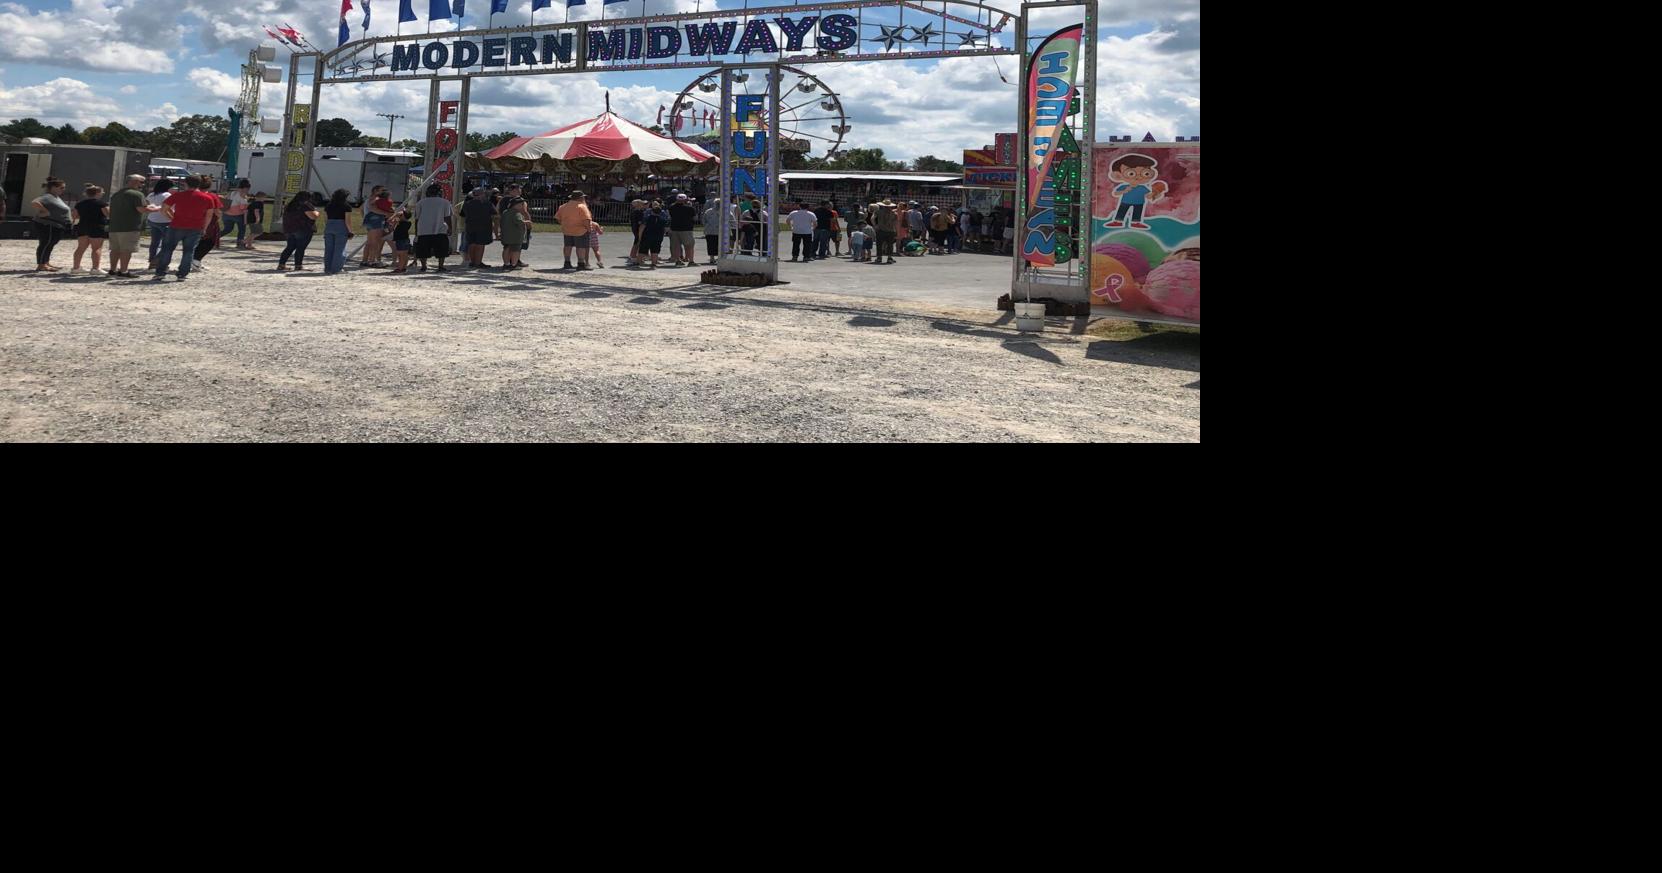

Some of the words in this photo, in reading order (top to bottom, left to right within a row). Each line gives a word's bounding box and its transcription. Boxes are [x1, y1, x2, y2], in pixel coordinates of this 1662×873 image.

[390, 33, 572, 71] MODERN
[587, 14, 858, 61] MIDWAYS
[733, 94, 767, 196] FUN
